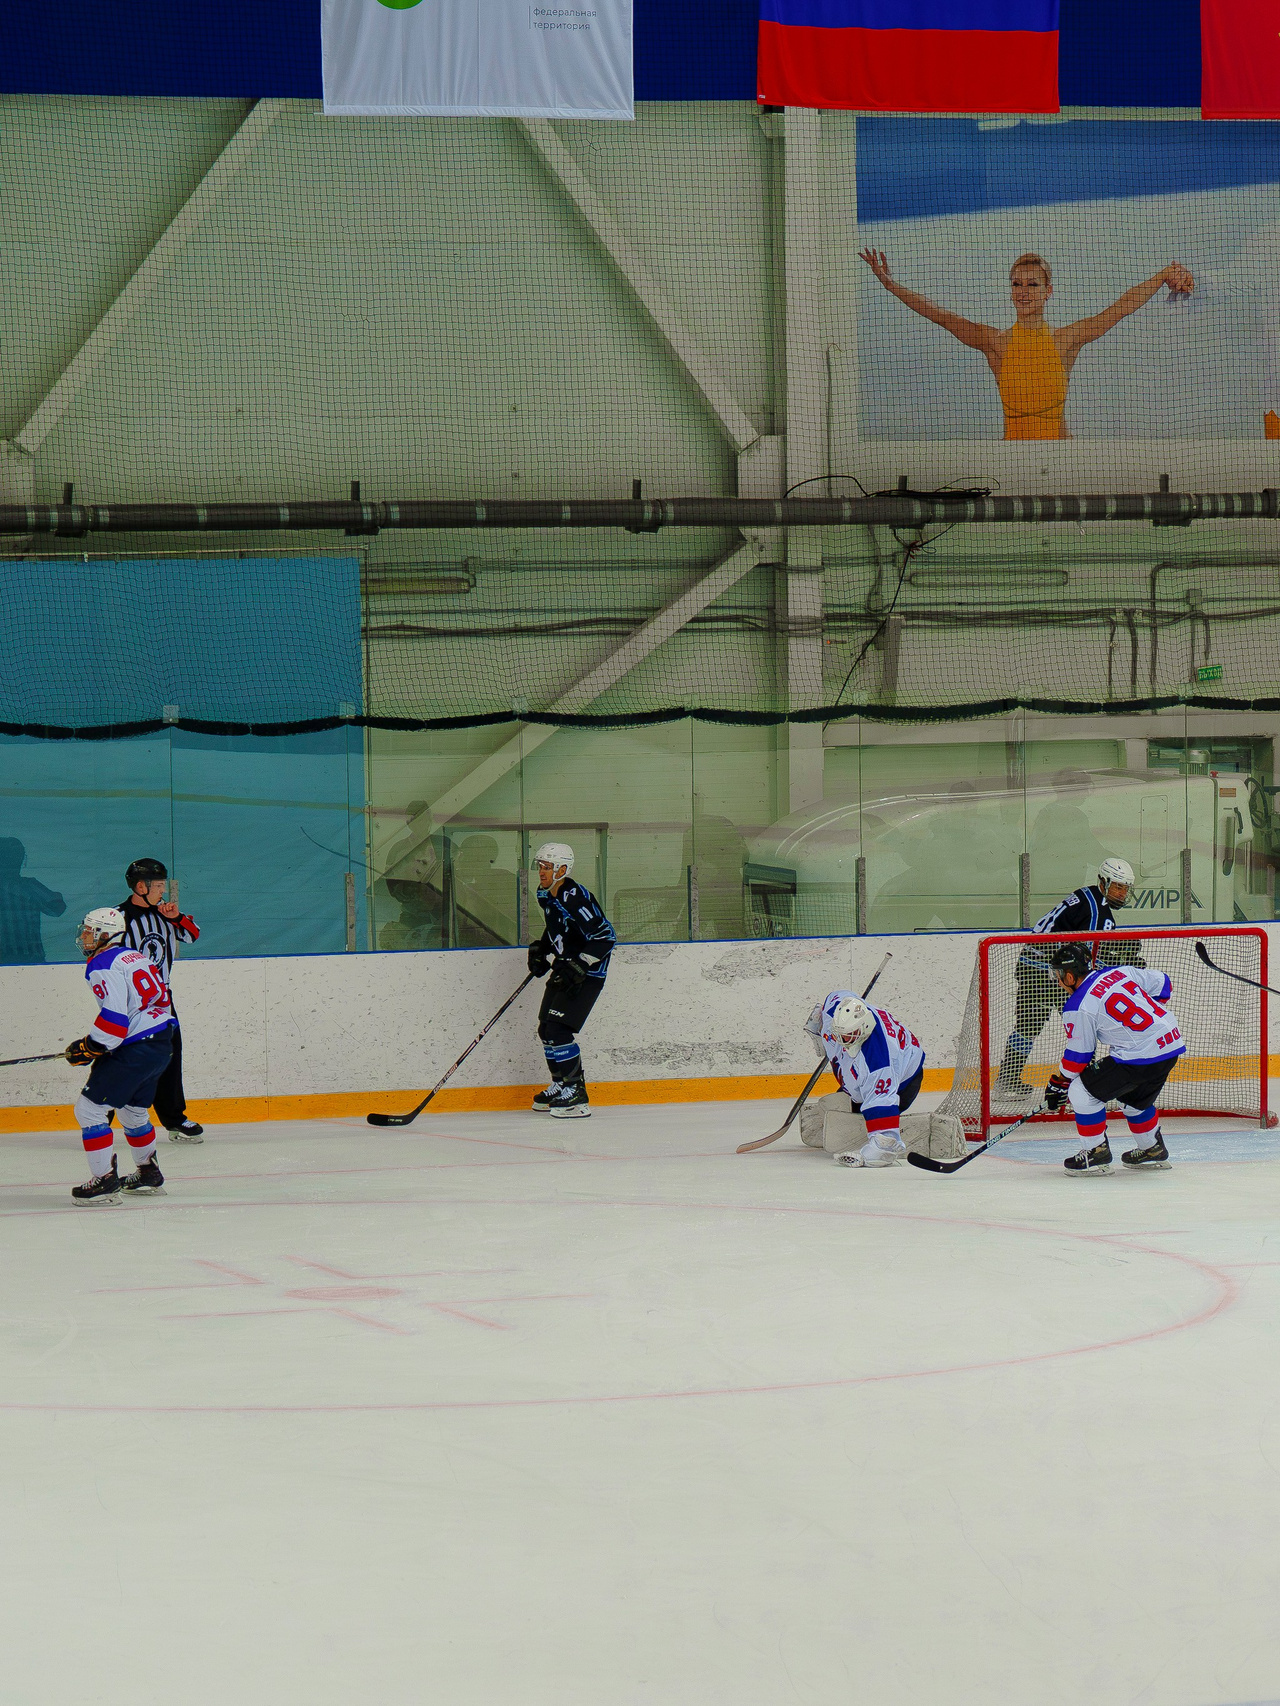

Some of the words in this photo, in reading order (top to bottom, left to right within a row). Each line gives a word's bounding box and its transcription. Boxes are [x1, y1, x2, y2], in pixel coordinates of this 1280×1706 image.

[533, 7, 597, 18] федеральная
[533, 21, 590, 31] территория
[578, 906, 593, 921] 11
[1105, 980, 1167, 1032] 87
